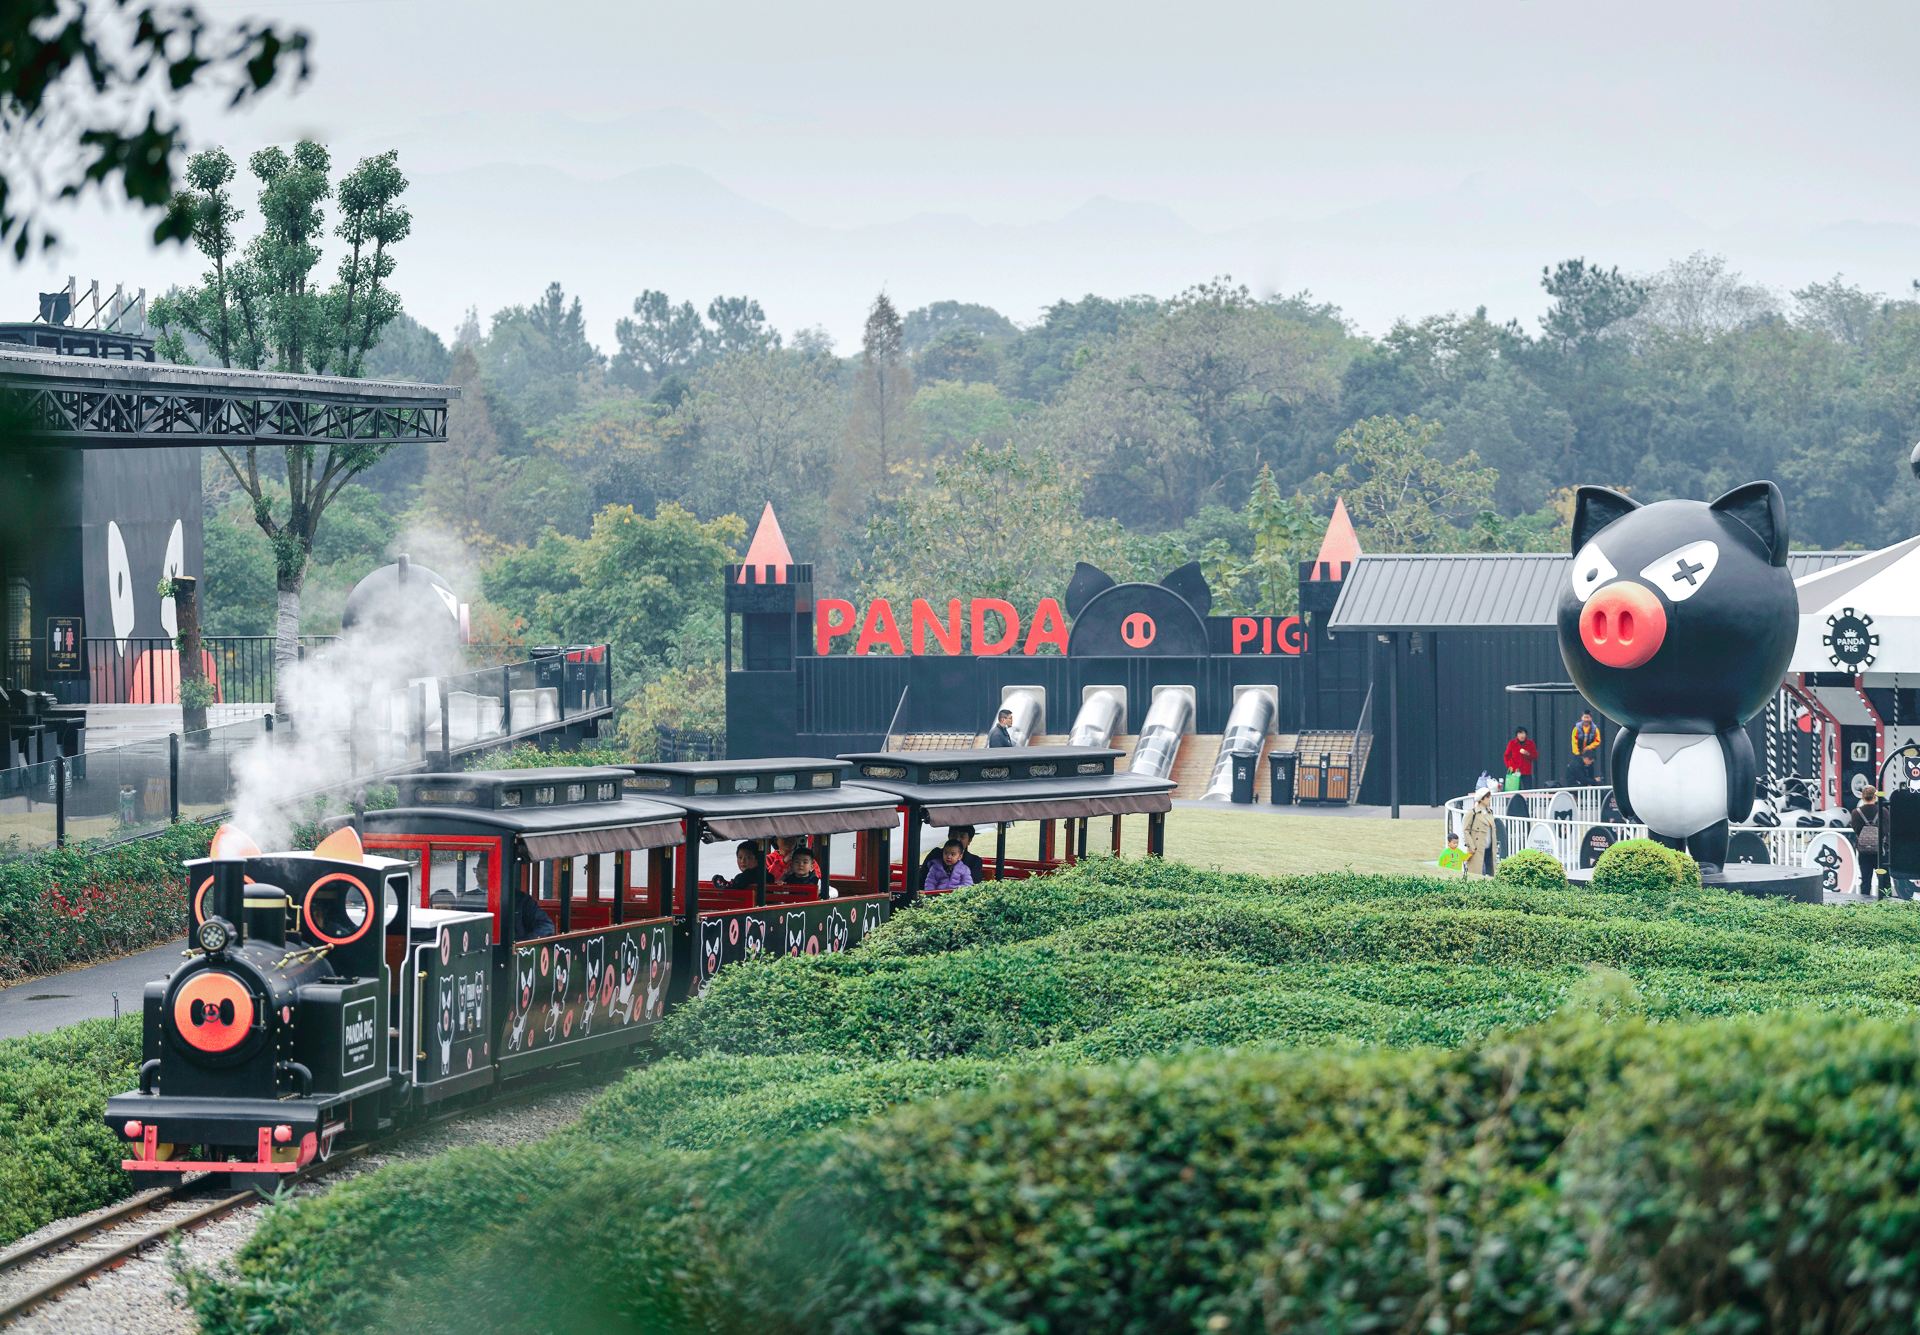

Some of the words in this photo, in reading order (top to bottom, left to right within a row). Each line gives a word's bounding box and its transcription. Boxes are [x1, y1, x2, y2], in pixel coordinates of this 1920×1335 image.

[816, 598, 1069, 656] PANDA
[1232, 616, 1308, 655] PIG
[345, 1021, 363, 1046] PANDA
[364, 1019, 373, 1041] PIG
